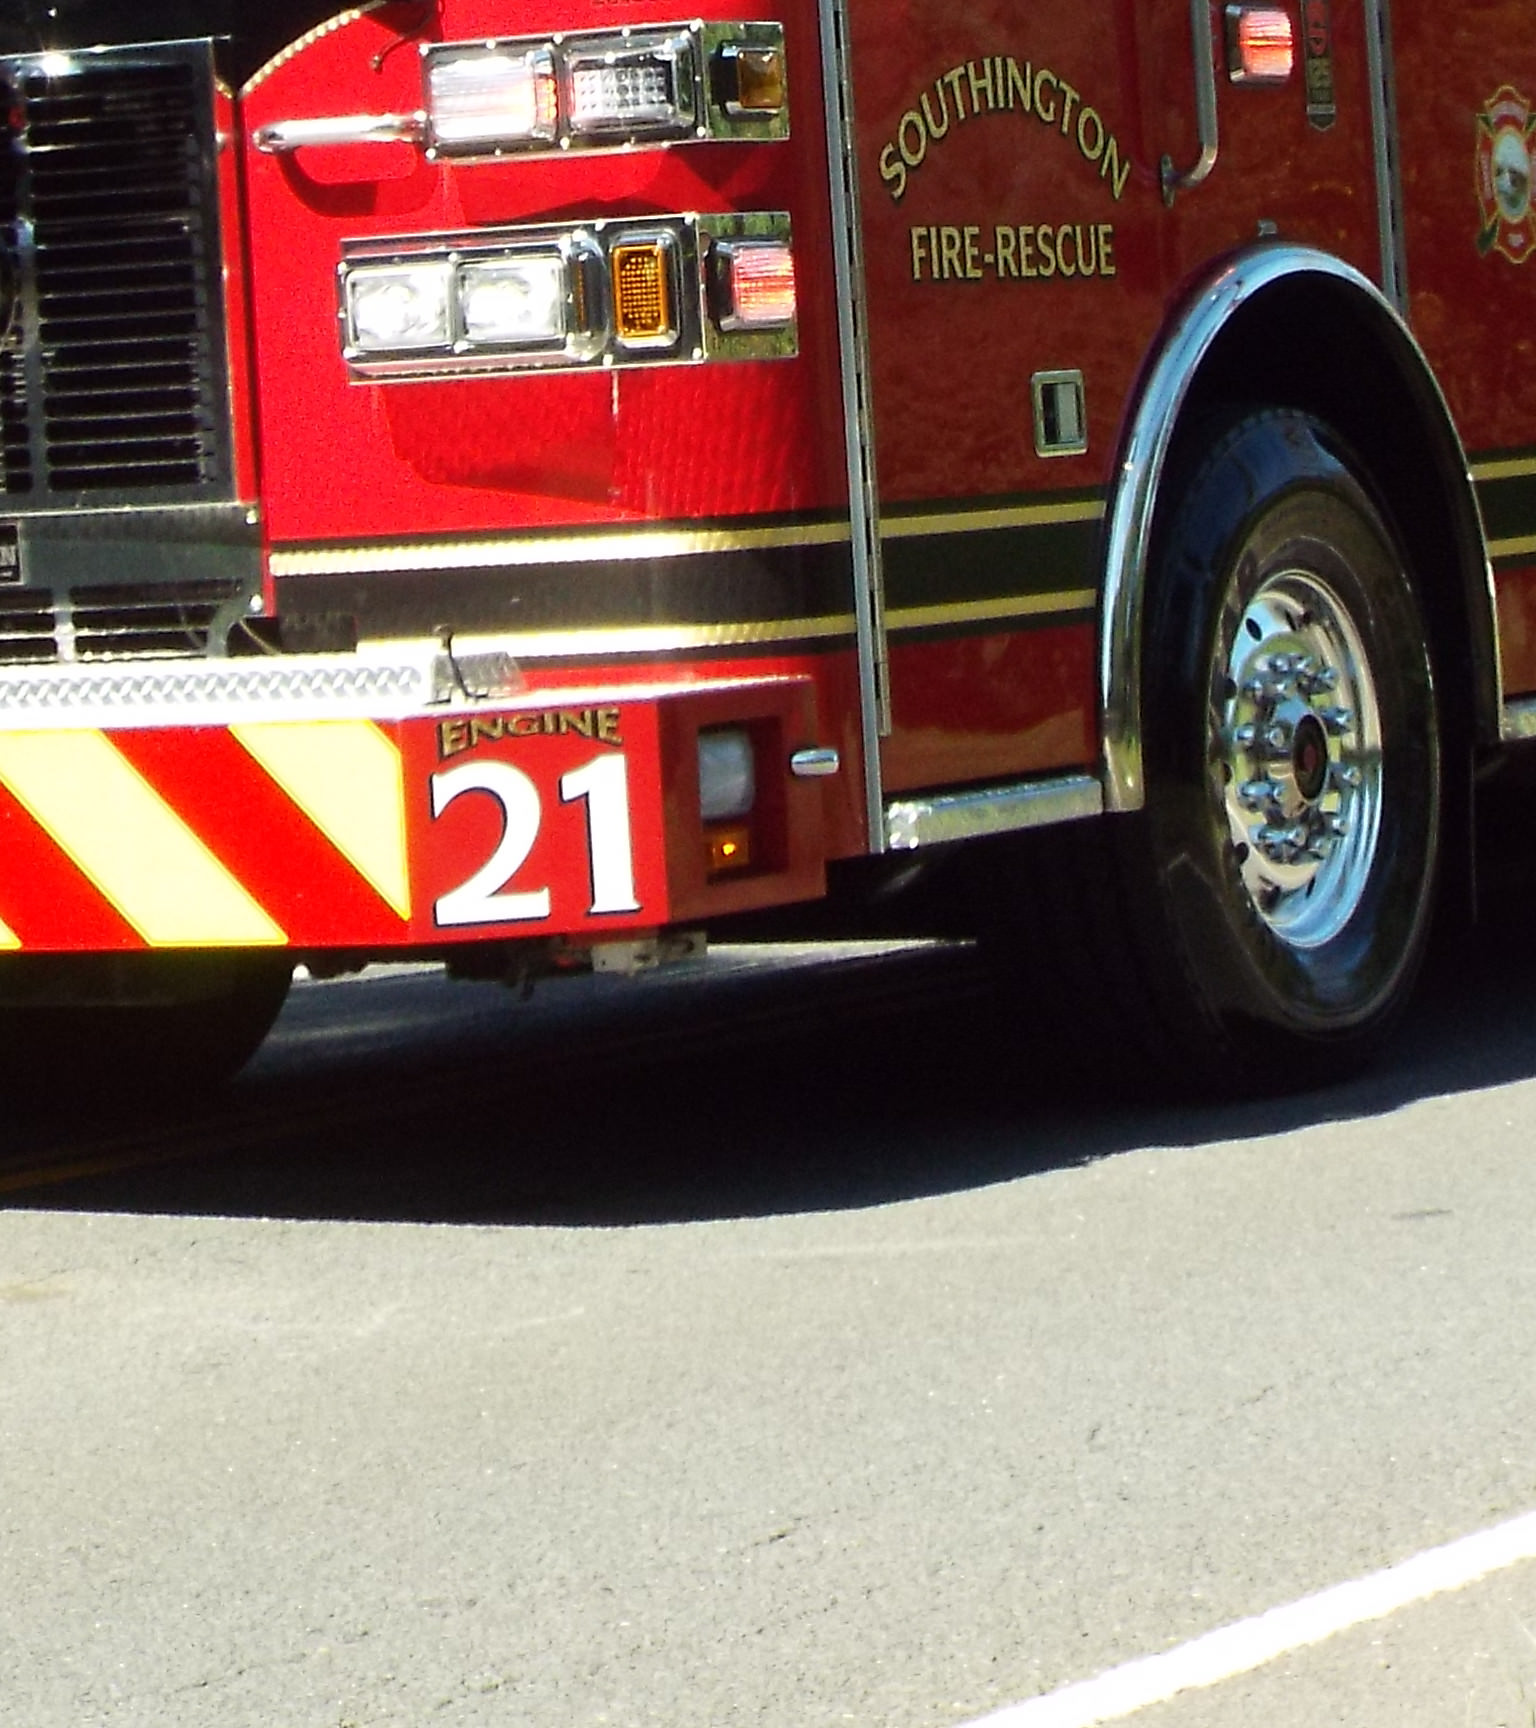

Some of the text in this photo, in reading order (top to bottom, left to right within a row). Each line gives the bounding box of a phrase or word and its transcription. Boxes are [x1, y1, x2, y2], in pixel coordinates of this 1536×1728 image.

[879, 56, 1131, 200] SOUTHINGTON
[910, 223, 1117, 281] FIRE-RESCUE
[436, 708, 623, 759] ENGINE
[430, 752, 642, 928] 21
